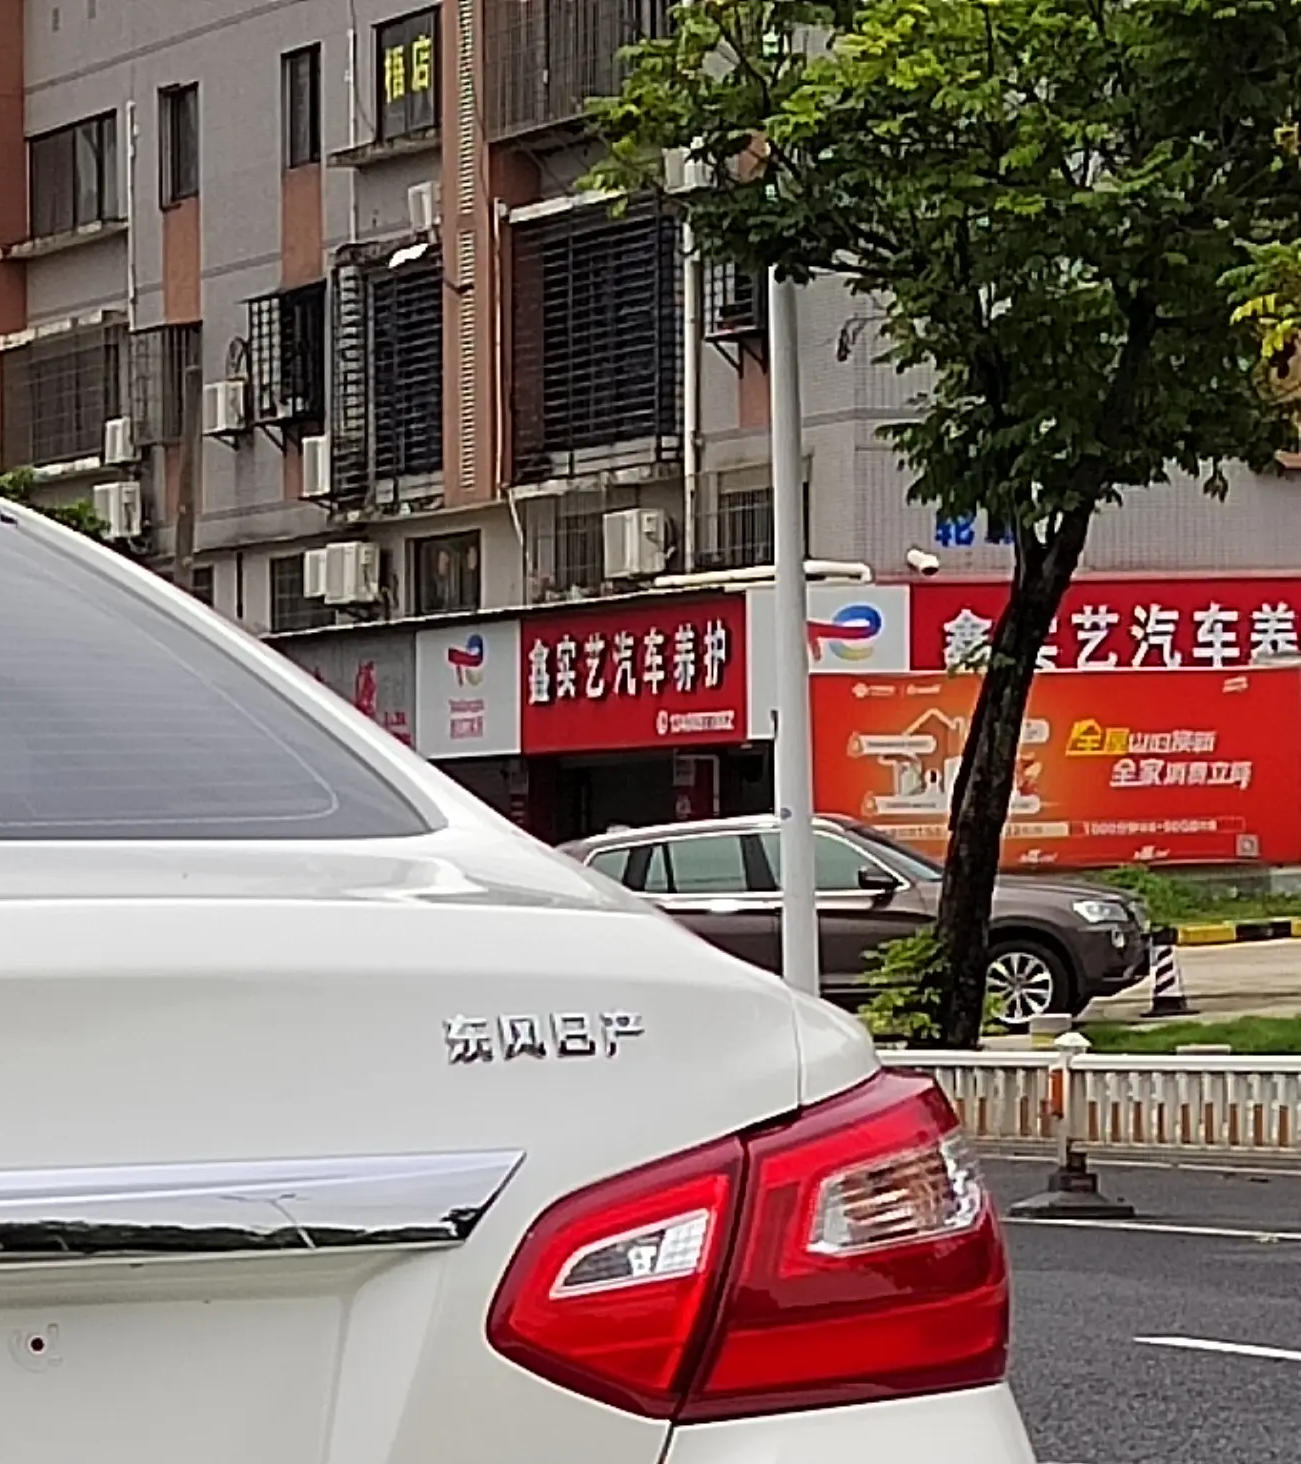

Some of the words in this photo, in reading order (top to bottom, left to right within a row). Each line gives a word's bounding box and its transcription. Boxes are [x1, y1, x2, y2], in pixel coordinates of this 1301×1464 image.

[528, 616, 727, 705] 鑫实艺汽车养护
[942, 600, 1299, 670] 鑫艺汽车养
[442, 1008, 645, 1064] 东风日产
